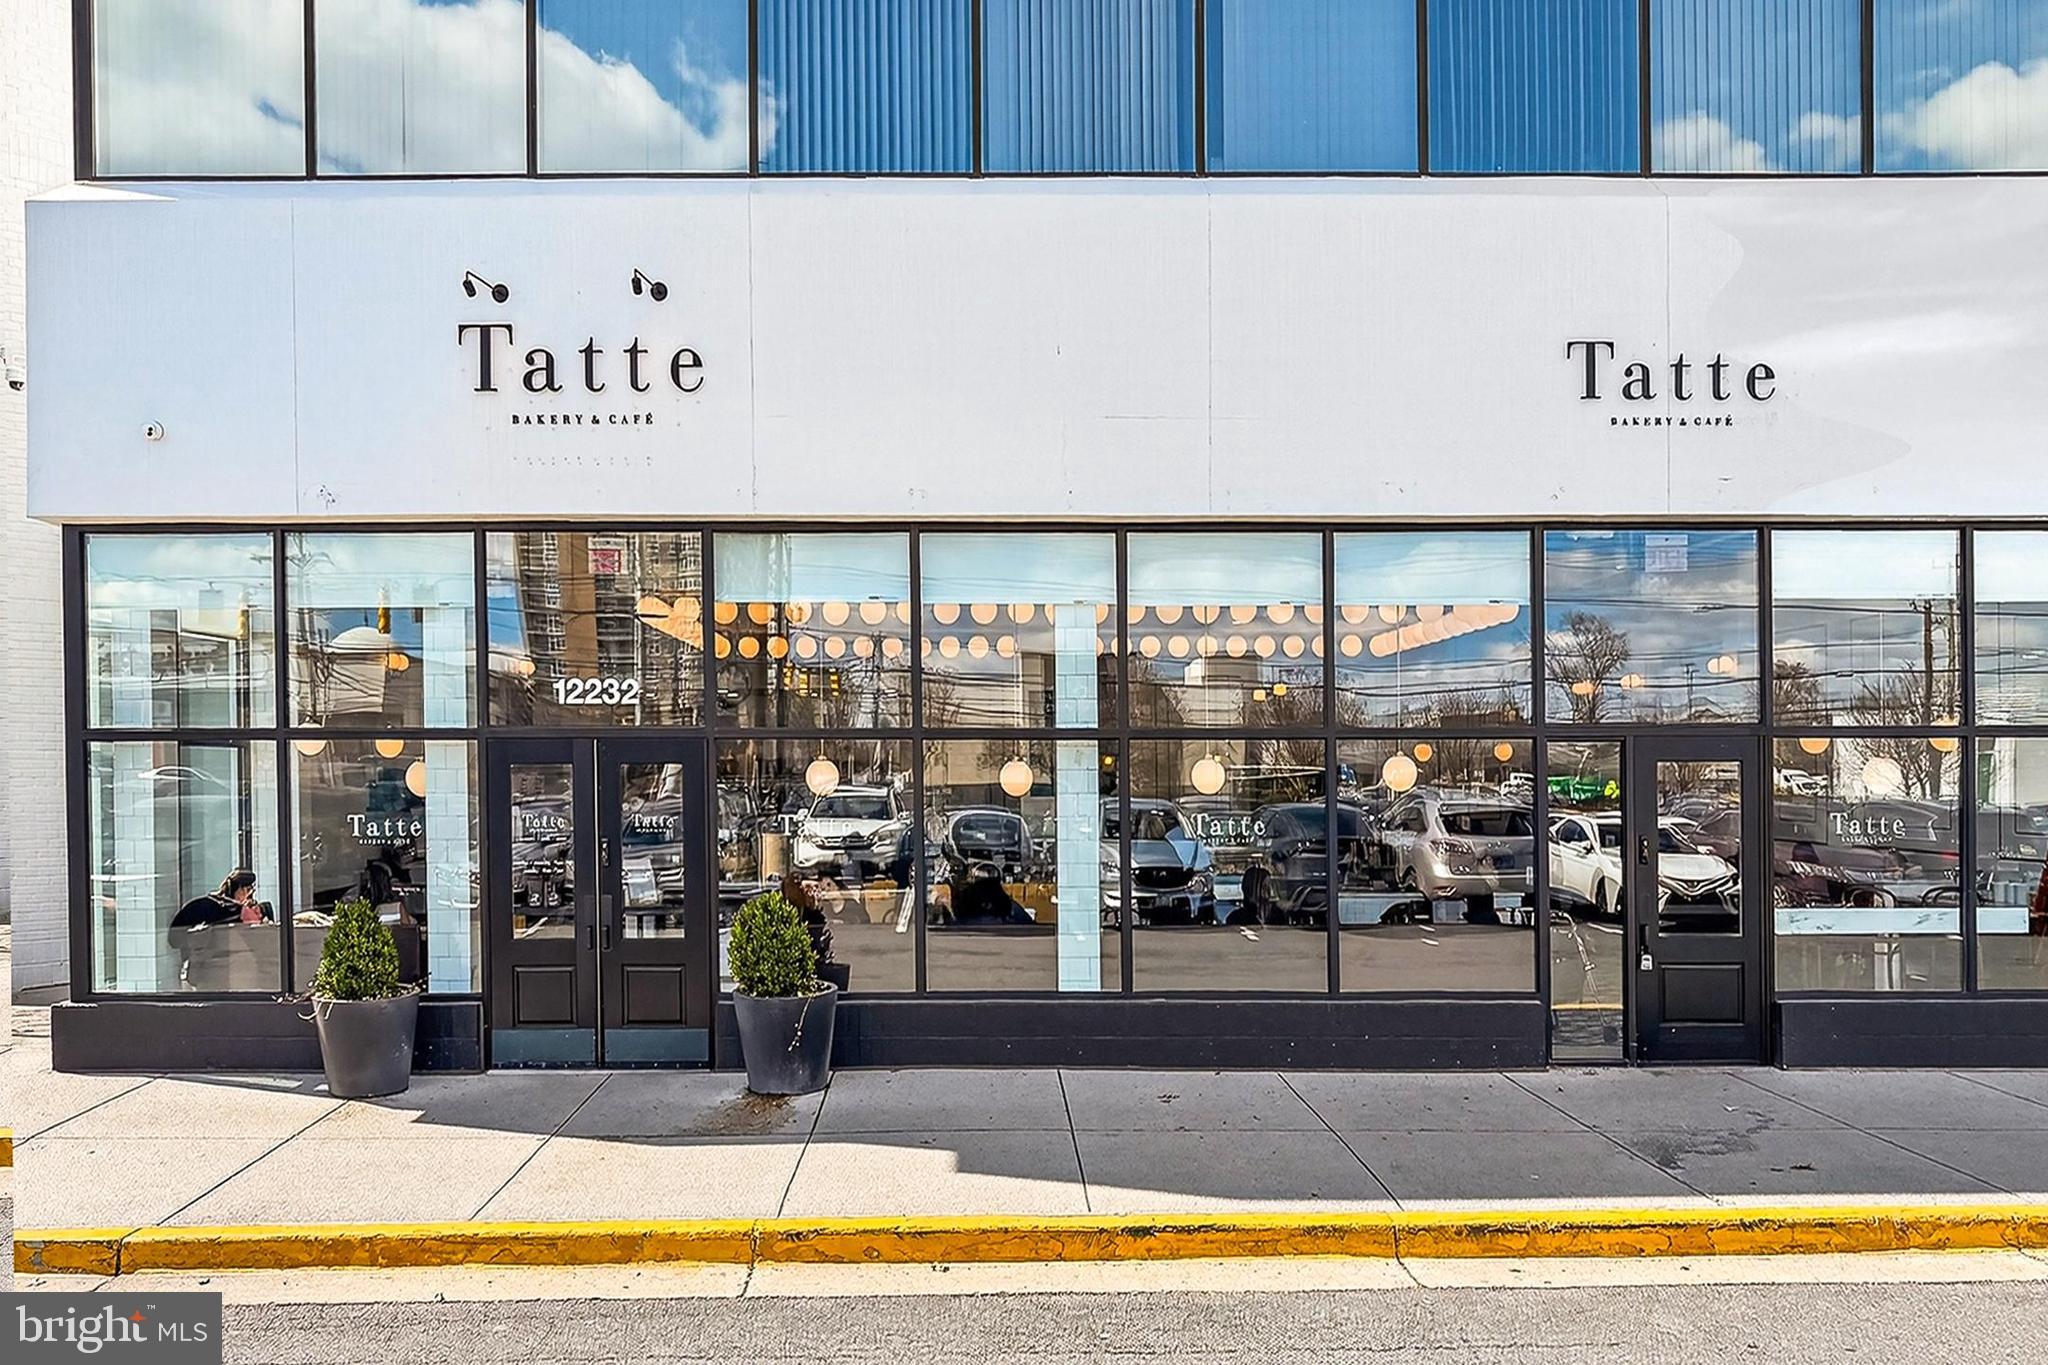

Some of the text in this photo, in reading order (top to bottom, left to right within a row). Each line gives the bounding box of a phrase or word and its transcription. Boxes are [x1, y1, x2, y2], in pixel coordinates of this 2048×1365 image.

[457, 323, 705, 393] Tatte
[1566, 340, 1776, 402] Tatte
[511, 411, 654, 425] BAKERY & CAFÉ
[552, 677, 640, 705] 12232
[346, 813, 423, 837] Tatte
[1829, 812, 1906, 837] Tatte
